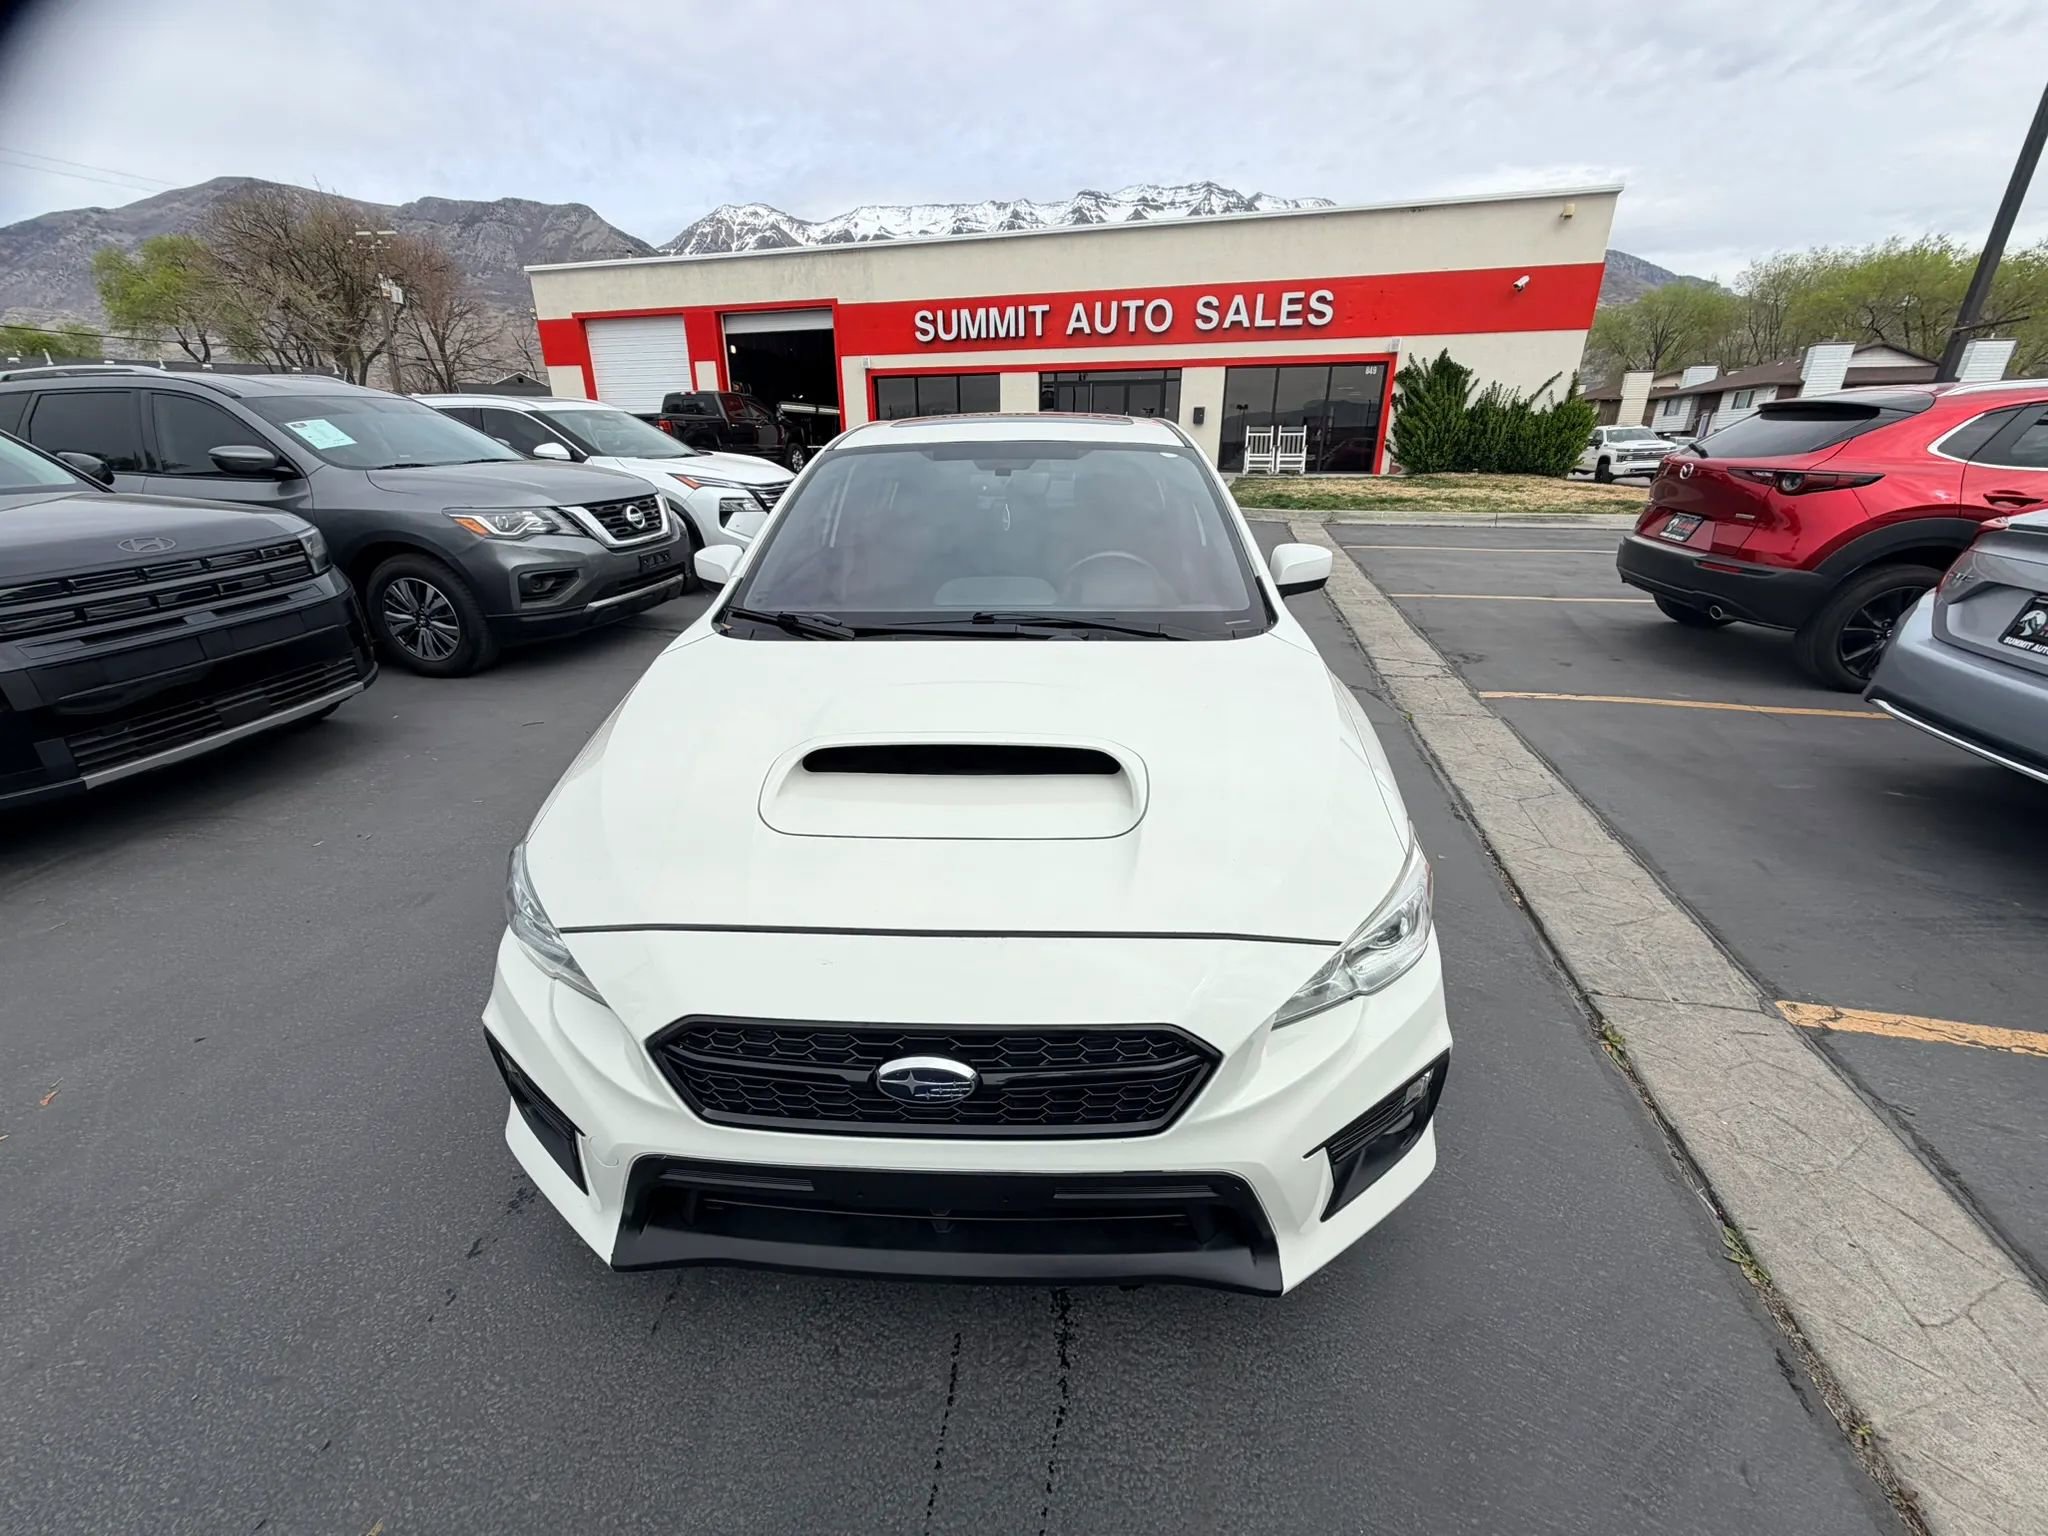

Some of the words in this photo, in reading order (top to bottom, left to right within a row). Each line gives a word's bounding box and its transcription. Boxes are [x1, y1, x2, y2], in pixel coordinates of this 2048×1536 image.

[914, 304, 1050, 342] SUMMIT
[1066, 299, 1173, 335] AUTO
[1195, 290, 1334, 330] SALES
[2003, 636, 2034, 649] SUMMIT
